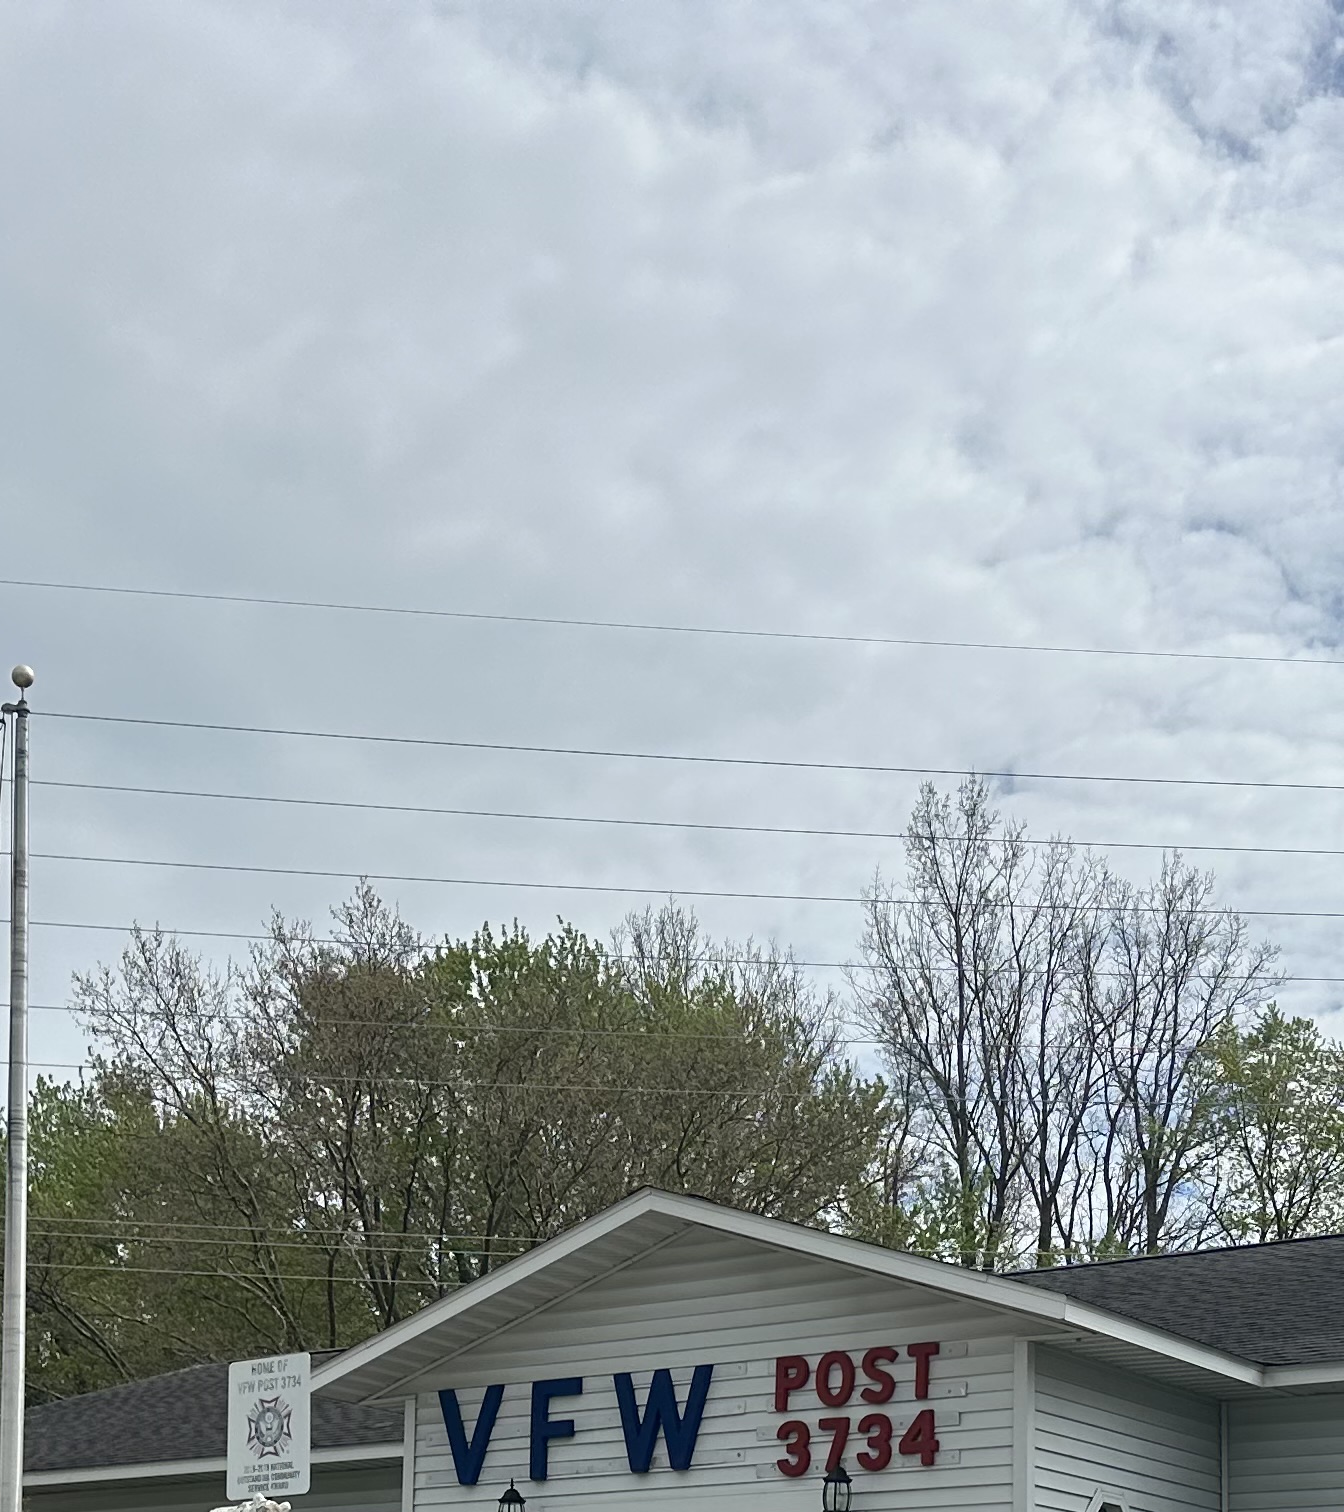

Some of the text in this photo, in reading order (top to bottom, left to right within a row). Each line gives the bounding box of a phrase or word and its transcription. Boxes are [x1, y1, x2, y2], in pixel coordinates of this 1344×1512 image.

[238, 1374, 301, 1394] VFW POST 3734
[251, 1359, 288, 1376] HOME OF
[775, 1341, 940, 1413] POST
[775, 1408, 940, 1477] 3734
